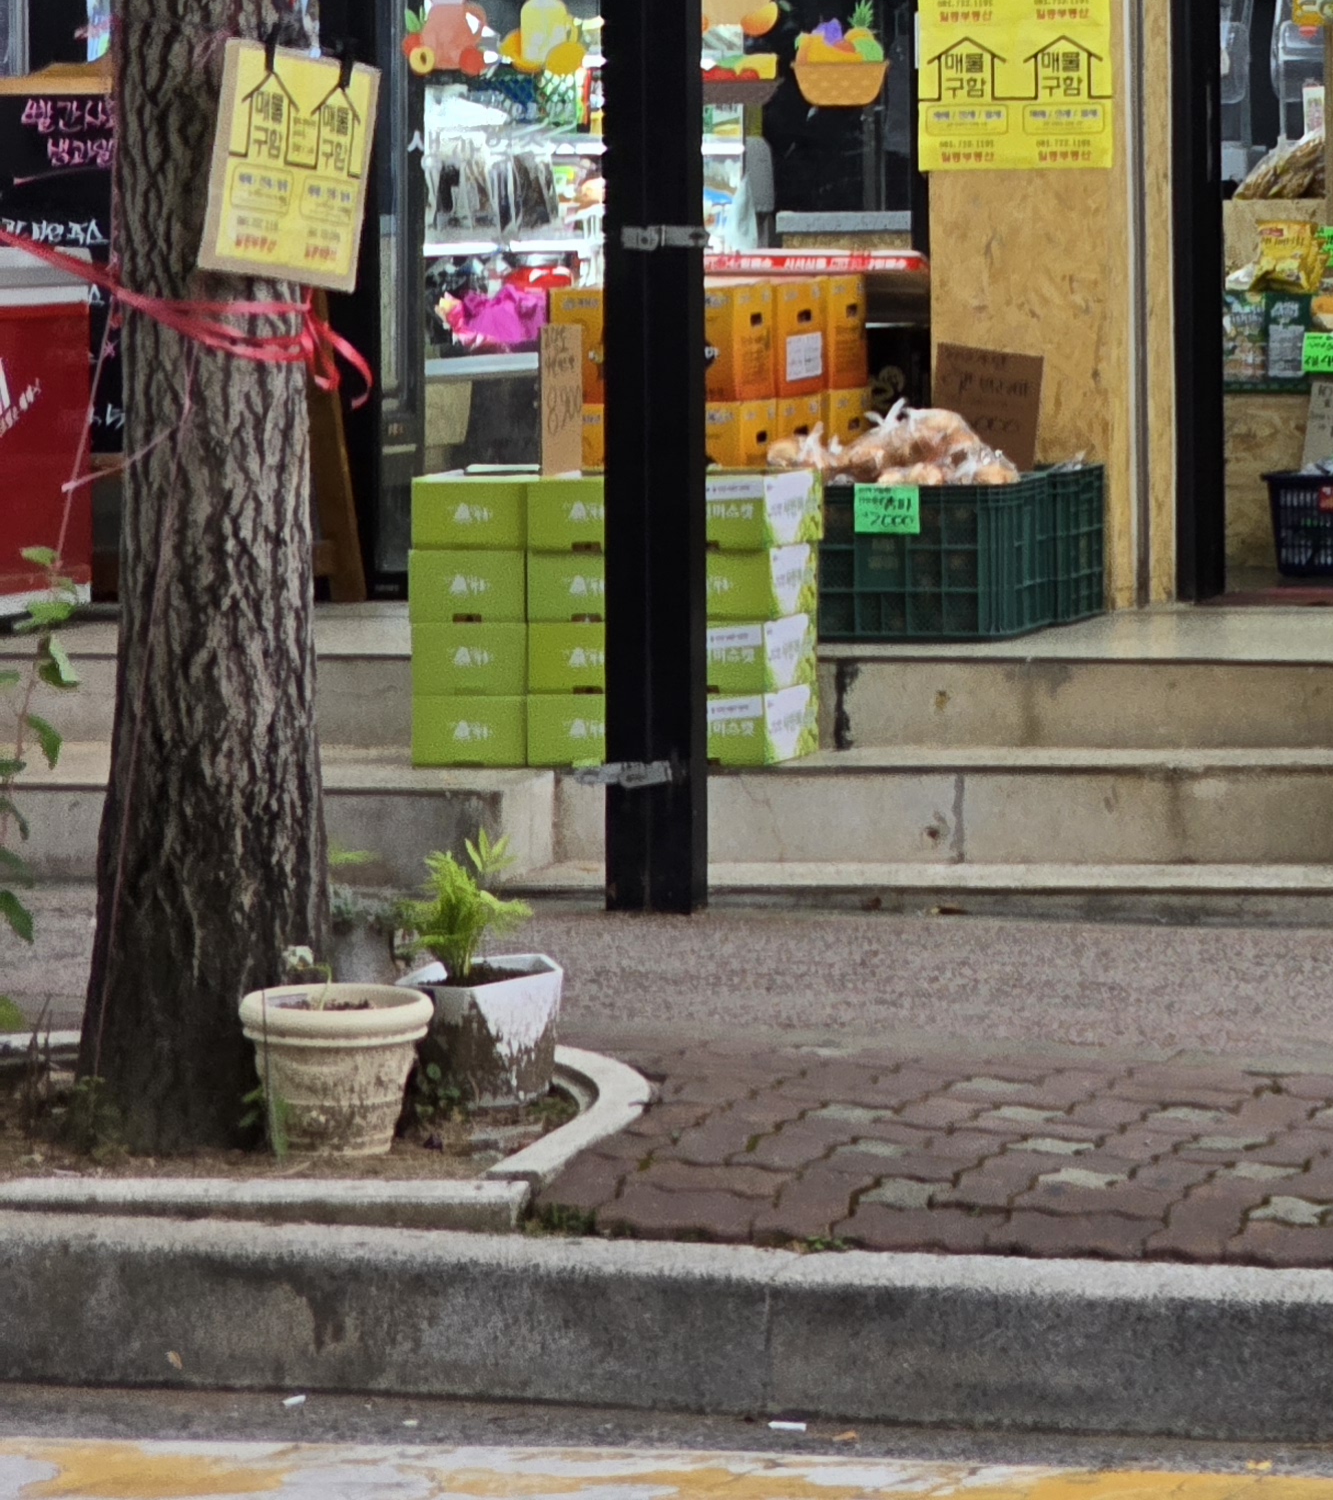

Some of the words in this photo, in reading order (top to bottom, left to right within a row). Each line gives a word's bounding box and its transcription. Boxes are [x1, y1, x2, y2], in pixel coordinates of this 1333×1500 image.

[944, 76, 987, 99] 구함
[1041, 75, 1083, 98] 구함
[21, 98, 114, 134] 빨간사
